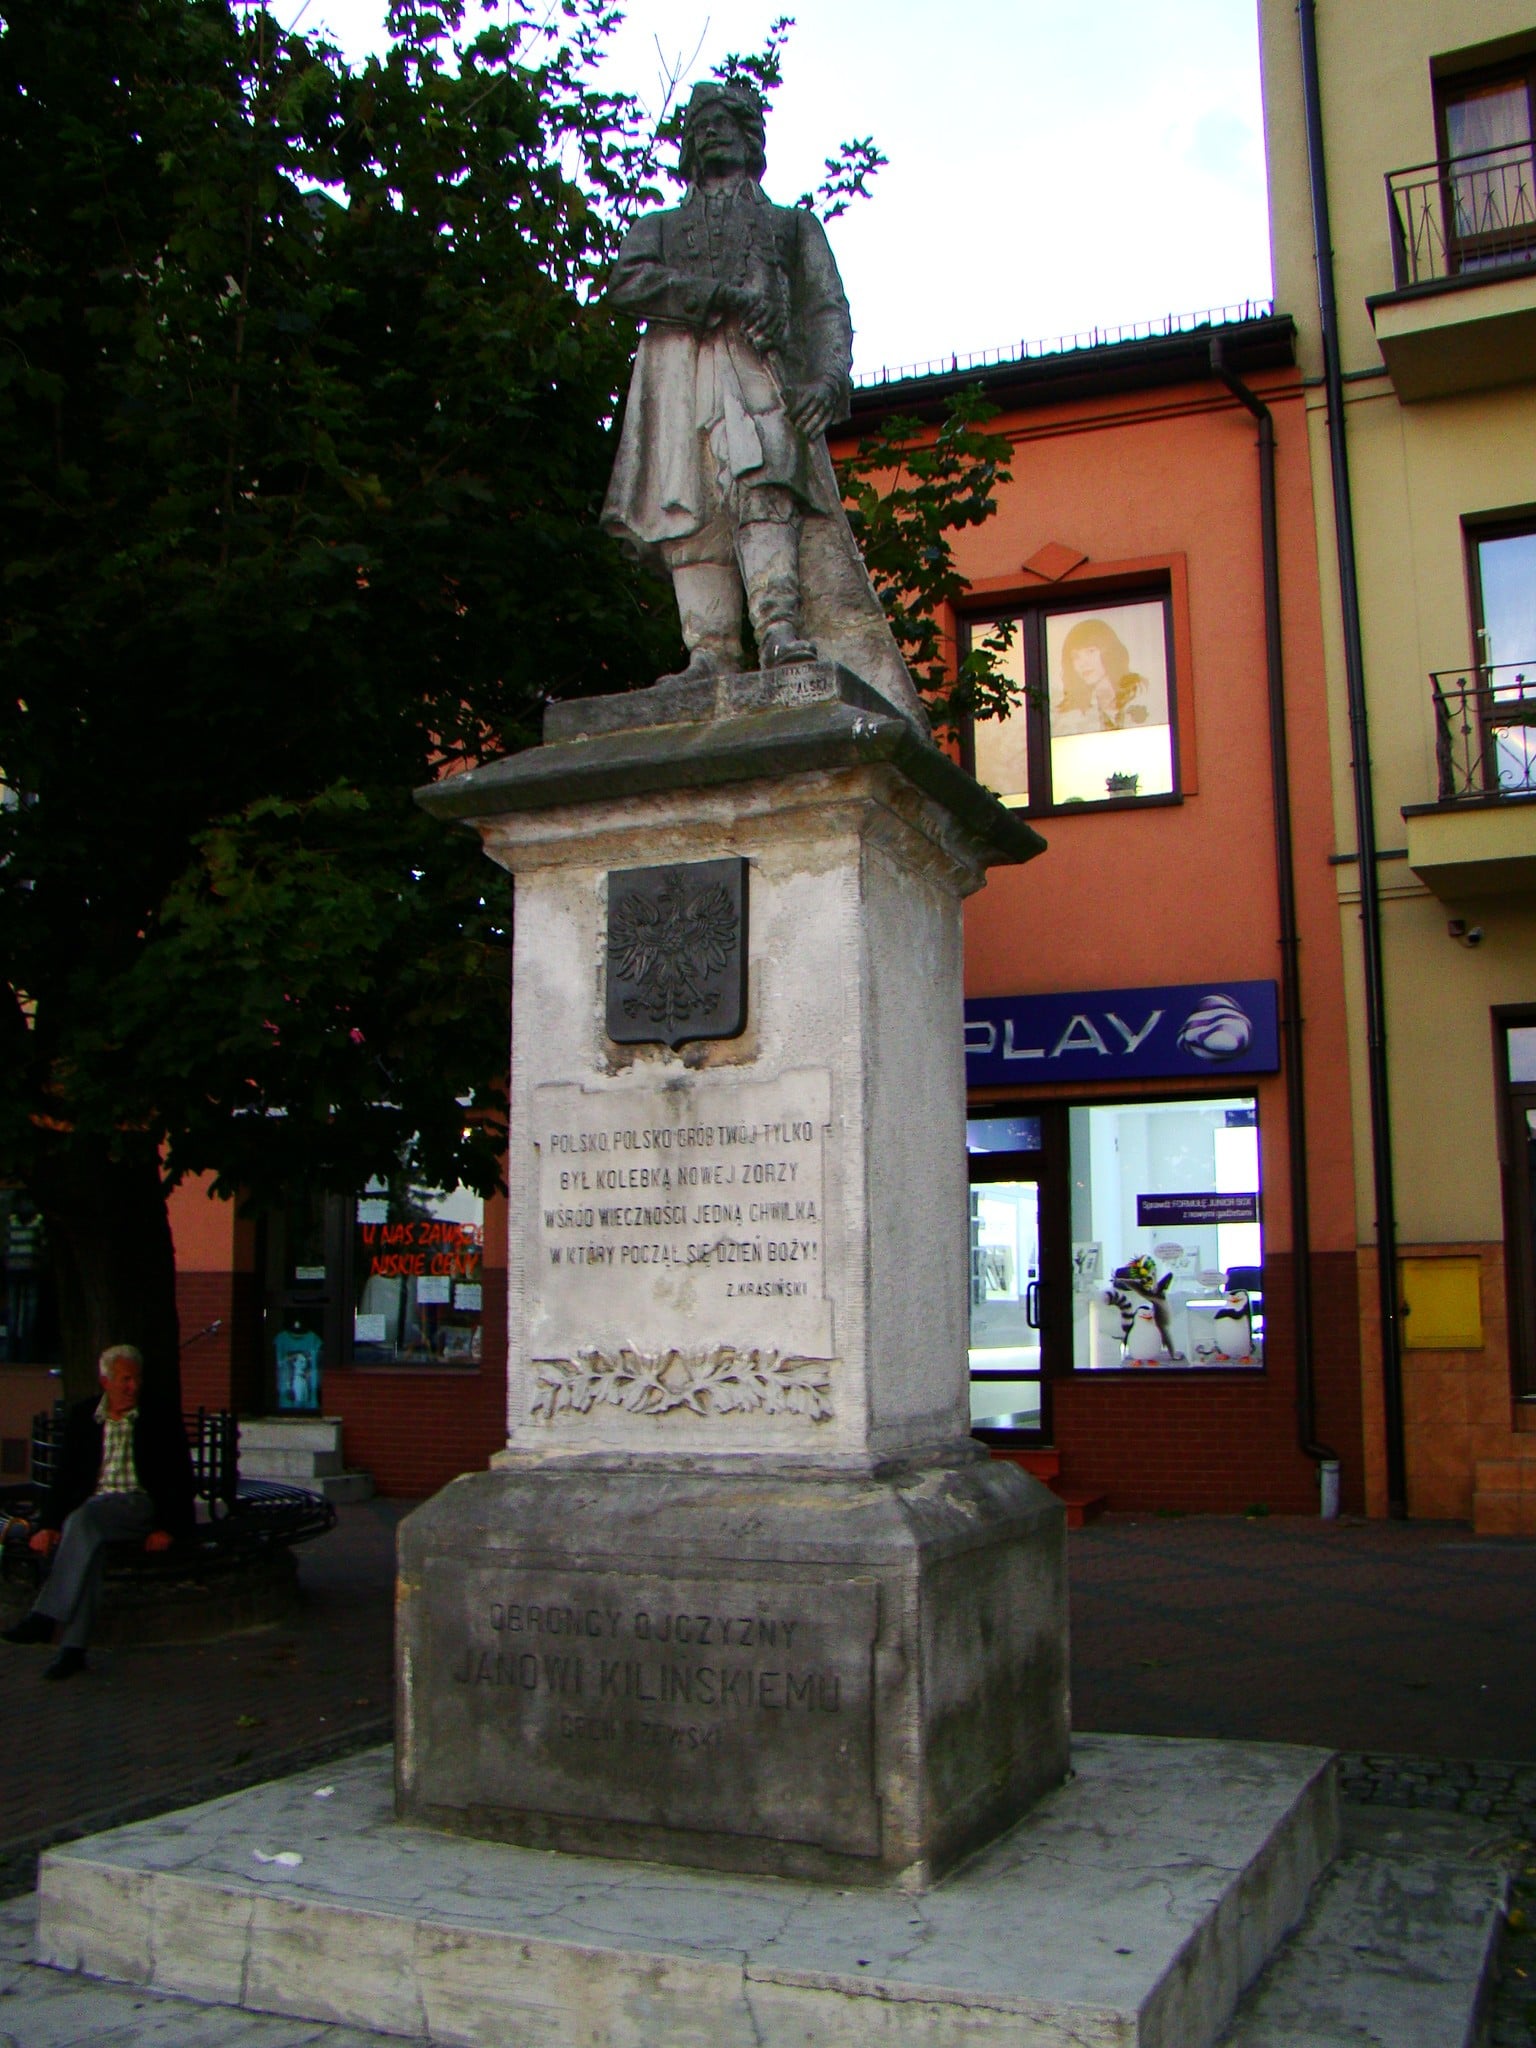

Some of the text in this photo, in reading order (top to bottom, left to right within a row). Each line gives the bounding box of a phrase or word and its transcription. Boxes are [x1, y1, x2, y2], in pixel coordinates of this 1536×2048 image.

[613, 1128, 671, 1150] POLSKO
[678, 1122, 714, 1147] GRÓB
[718, 1120, 757, 1145] TWÓJ
[764, 1121, 813, 1142] TYLKO
[560, 1162, 799, 1190] BYŁ KOLEBKĄ NOWEJ ZORZY
[544, 1202, 594, 1228] WŚRÓD
[598, 1200, 687, 1227] WIECZNOŚCI
[692, 1203, 741, 1226] JEDNĄ
[363, 1223, 376, 1245] U
[380, 1221, 415, 1246] NAS
[370, 1251, 479, 1277] NISKIE CENY
[550, 1247, 561, 1264] W
[621, 1244, 681, 1268] POCZĄŁ
[717, 1235, 762, 1262] DZIEŃ
[768, 1238, 817, 1261] BOŻY!
[635, 1611, 799, 1649] OJCZYZNY
[454, 1648, 582, 1694] JANOWI
